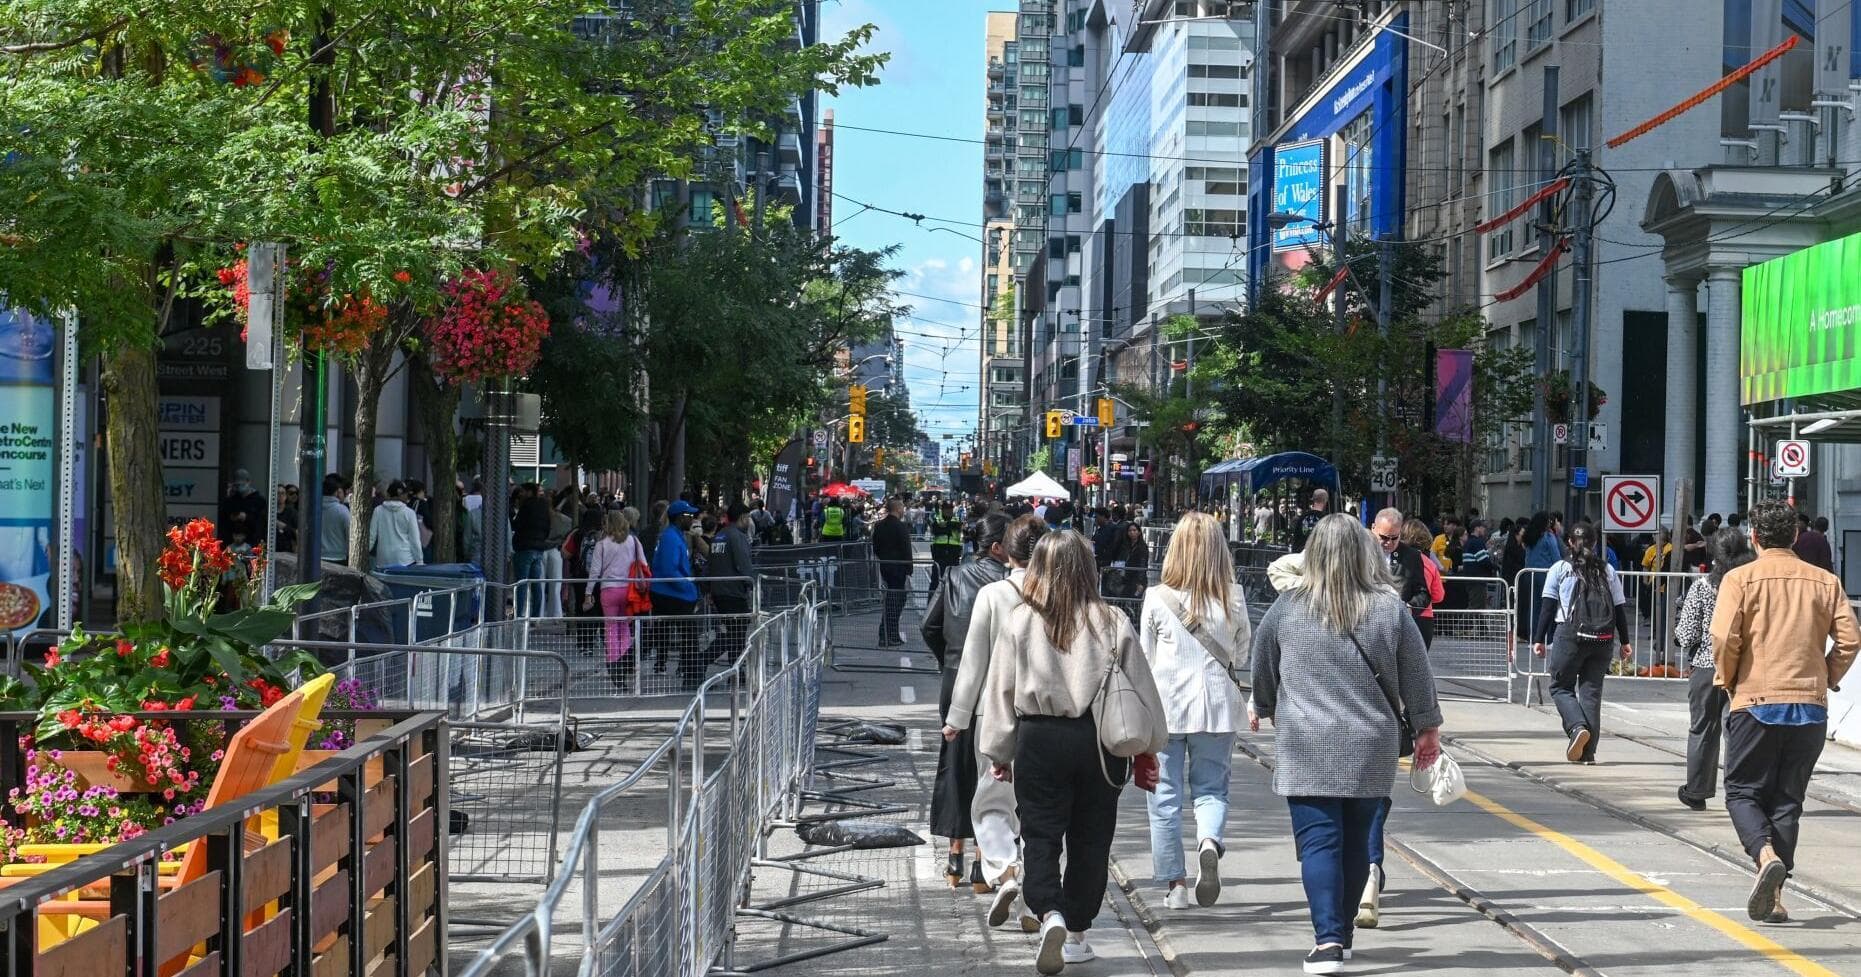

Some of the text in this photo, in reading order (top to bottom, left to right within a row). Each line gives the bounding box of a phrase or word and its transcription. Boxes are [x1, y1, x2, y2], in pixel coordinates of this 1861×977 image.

[1279, 156, 1318, 178] Princess
[1278, 181, 1318, 206] of Wales
[1809, 309, 1817, 332] A
[182, 336, 223, 356] 225
[198, 365, 228, 376] West
[159, 415, 205, 424] ASTER
[11, 422, 38, 434] New
[0, 449, 47, 460] ncourse
[1272, 465, 1315, 474] Priority Line
[0, 479, 45, 491] at's Next
[774, 475, 788, 483] FAN
[1372, 471, 1395, 488] 40
[773, 482, 792, 491] ZONE
